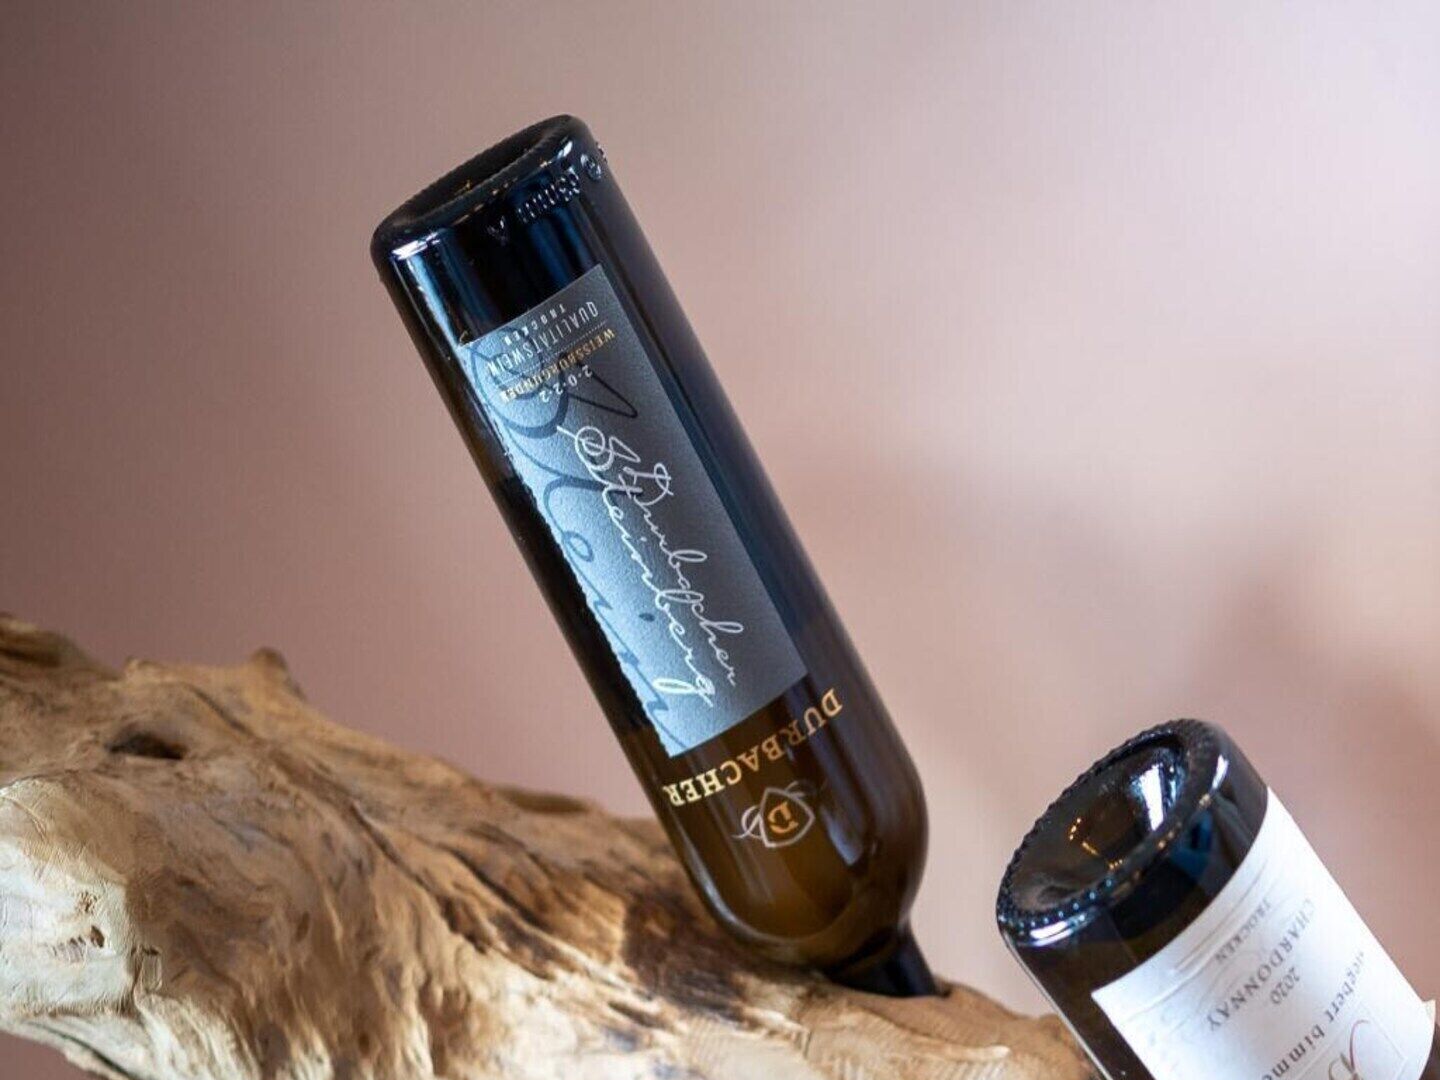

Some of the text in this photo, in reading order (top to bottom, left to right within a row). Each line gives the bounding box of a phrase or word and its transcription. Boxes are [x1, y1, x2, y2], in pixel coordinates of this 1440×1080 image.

[485, 301, 600, 377] QUALITÄTSWEIN
[504, 303, 566, 346] TROCKEN
[500, 328, 616, 404] WEISSBURGUNDER
[557, 426, 716, 707] Steinberg
[622, 462, 744, 687] Durbacher
[662, 687, 844, 808] DURBACHER
[1206, 898, 1316, 1031] CHARDONNAY
[1214, 899, 1271, 964] TROCKEN
[1269, 966, 1301, 1005] 2020
